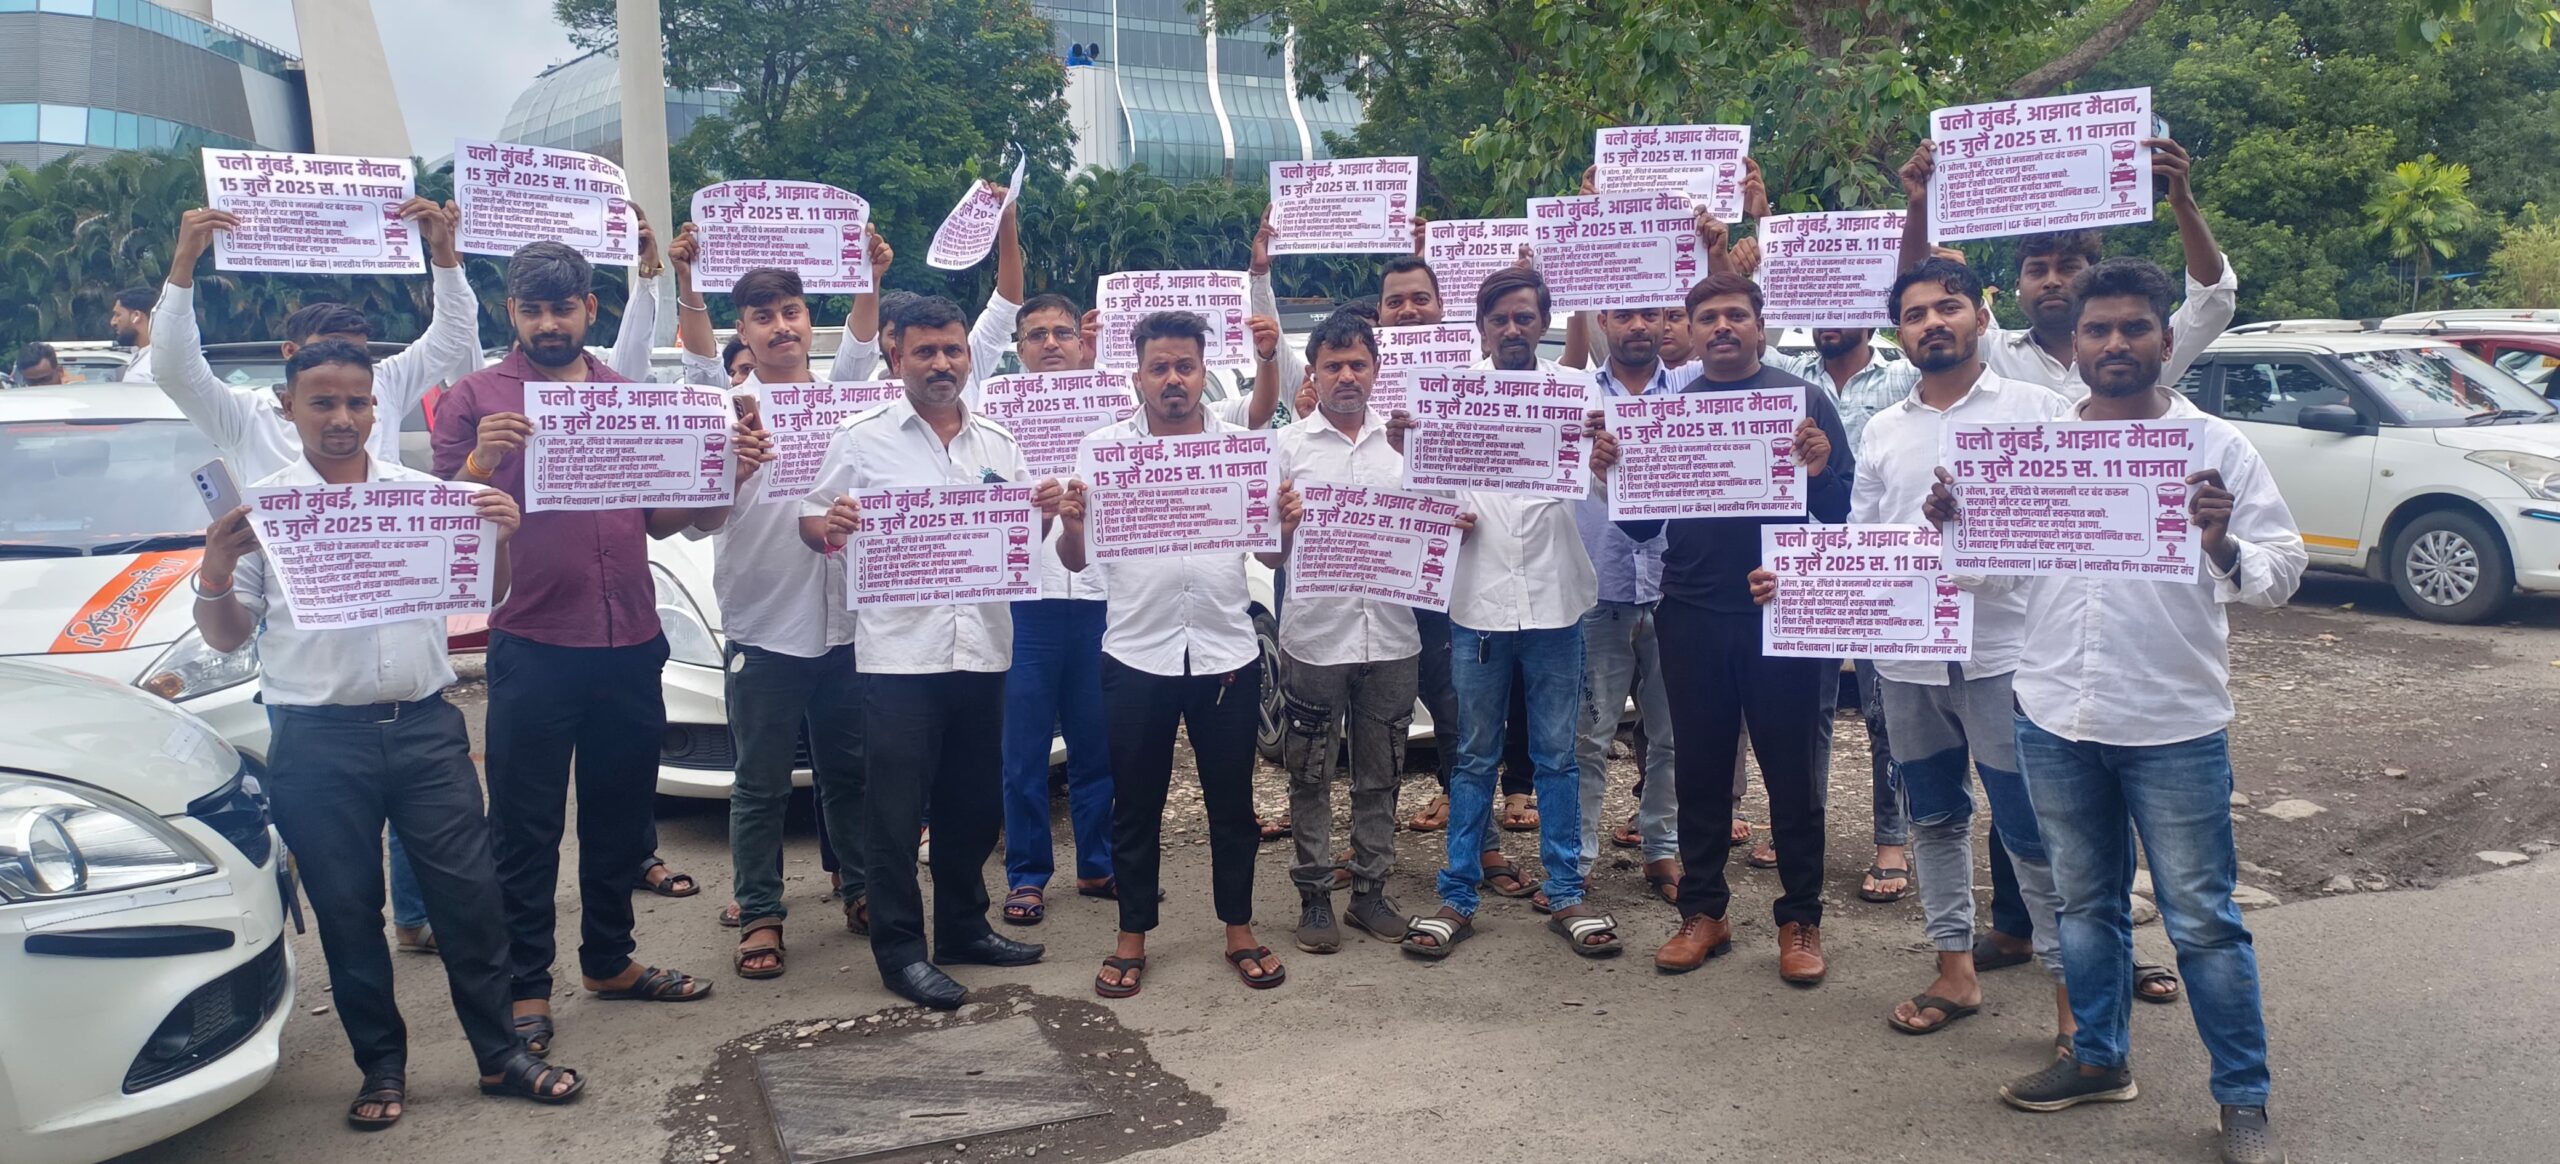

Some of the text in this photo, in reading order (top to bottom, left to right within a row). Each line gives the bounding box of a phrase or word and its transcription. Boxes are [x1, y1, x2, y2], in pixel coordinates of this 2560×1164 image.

[1941, 95, 2141, 133] चलो मुंबई, आझाद मैदान,
[1606, 127, 1743, 149] चलो मुंबई, आझाद मैदान,
[1939, 120, 2137, 159] 15 जुलै 2025 स. 11 वाजता
[219, 152, 406, 181] चलो मुंबई, आझाद मैदान,
[1282, 159, 1411, 181] चलो मुंबई, आझाद मैदान,
[1603, 148, 1739, 167] 15 जुलै 2025 स. 11 वाजता
[220, 175, 403, 199] 15 जुलै 2025 स. 11 वाजता
[1280, 180, 1408, 199] 15 जुलै 2025 स. 11 वाजता
[541, 386, 728, 411] चलो मुंबई, आझाद मैदान,
[1421, 374, 1588, 402] चलो मुंबई, आझाद मैदान,
[1417, 397, 1584, 420] 15 जुलै 2025 स. 11 वाजता
[1617, 392, 1798, 422] चलो मुंबई, आझाद मैदान,
[540, 411, 727, 435] 15 जुलै 2025 स. 11 वाजता
[1617, 419, 1794, 445] 15 जुलै 2025 स. 11 वाजता
[1094, 435, 1270, 466] चलो मुंबई, आझाद मैदान,
[1955, 423, 2194, 457] चलो मुंबई, आझाद मैदान,
[1094, 461, 1268, 490] 15 जुलै 2025 स. 11 वाजता
[1954, 455, 2188, 484] 15 जुलै 2025 स. 11 वाजता
[261, 485, 427, 516] चलो मुंबई, आझाद
[262, 513, 483, 542] 15 जुलै 2025 स. 11 वाजता
[1956, 557, 2194, 576] बघतोय रिक्षावाला IGF कॅब्स भारतीय गिग कामगार मंच
